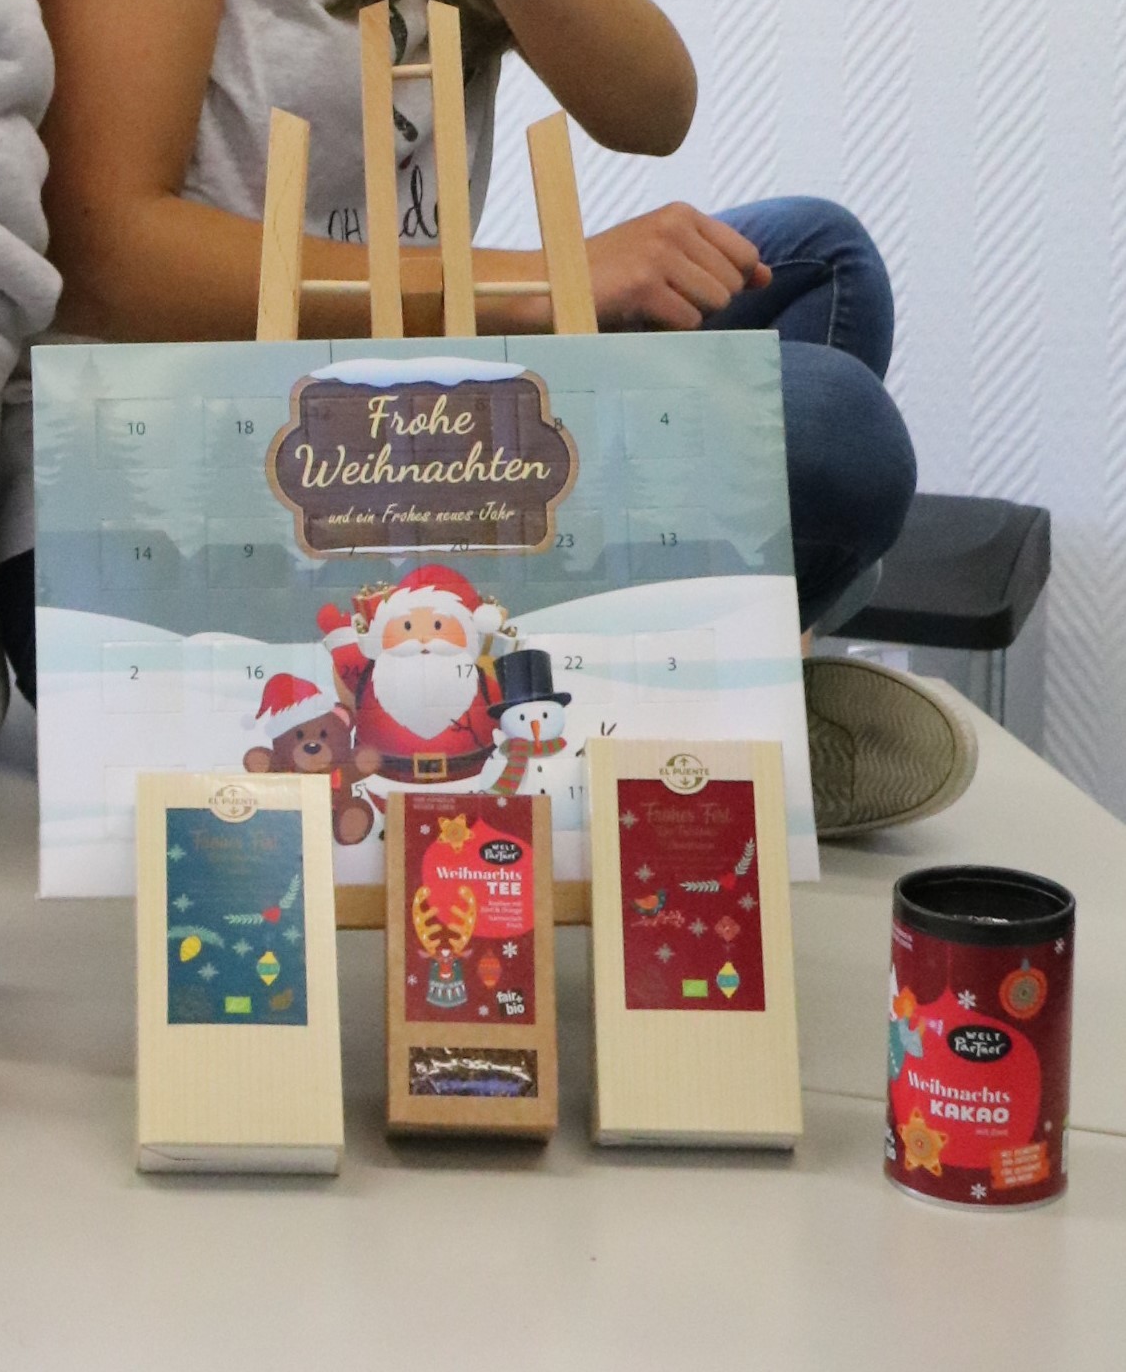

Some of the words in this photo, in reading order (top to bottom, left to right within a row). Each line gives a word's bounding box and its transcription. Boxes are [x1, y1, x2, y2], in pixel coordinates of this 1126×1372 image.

[367, 394, 474, 439] Frohe
[660, 412, 670, 426] 4
[127, 422, 145, 436] 10
[235, 420, 254, 435] 18
[294, 441, 551, 489] Weihnachten
[328, 506, 353, 525] und
[356, 509, 375, 524] ein
[381, 503, 429, 523] Frohes
[435, 510, 473, 522] neues
[478, 501, 516, 522] Jahr
[555, 533, 574, 548] 23
[660, 533, 678, 547] 13
[134, 546, 152, 560] 14
[244, 544, 254, 558] 9
[456, 664, 473, 678] 17
[564, 656, 583, 671] 22
[667, 657, 677, 672] 3
[130, 666, 140, 680] 2
[245, 665, 264, 680] 16
[354, 784, 363, 798] 5
[436, 866, 522, 881] Weihnachts
[487, 881, 522, 896] TEE
[505, 1003, 525, 1016] bio
[966, 1031, 1000, 1041] WELT
[908, 1070, 1010, 1103] Weihnachts
[930, 1099, 1010, 1124] KAKAO
